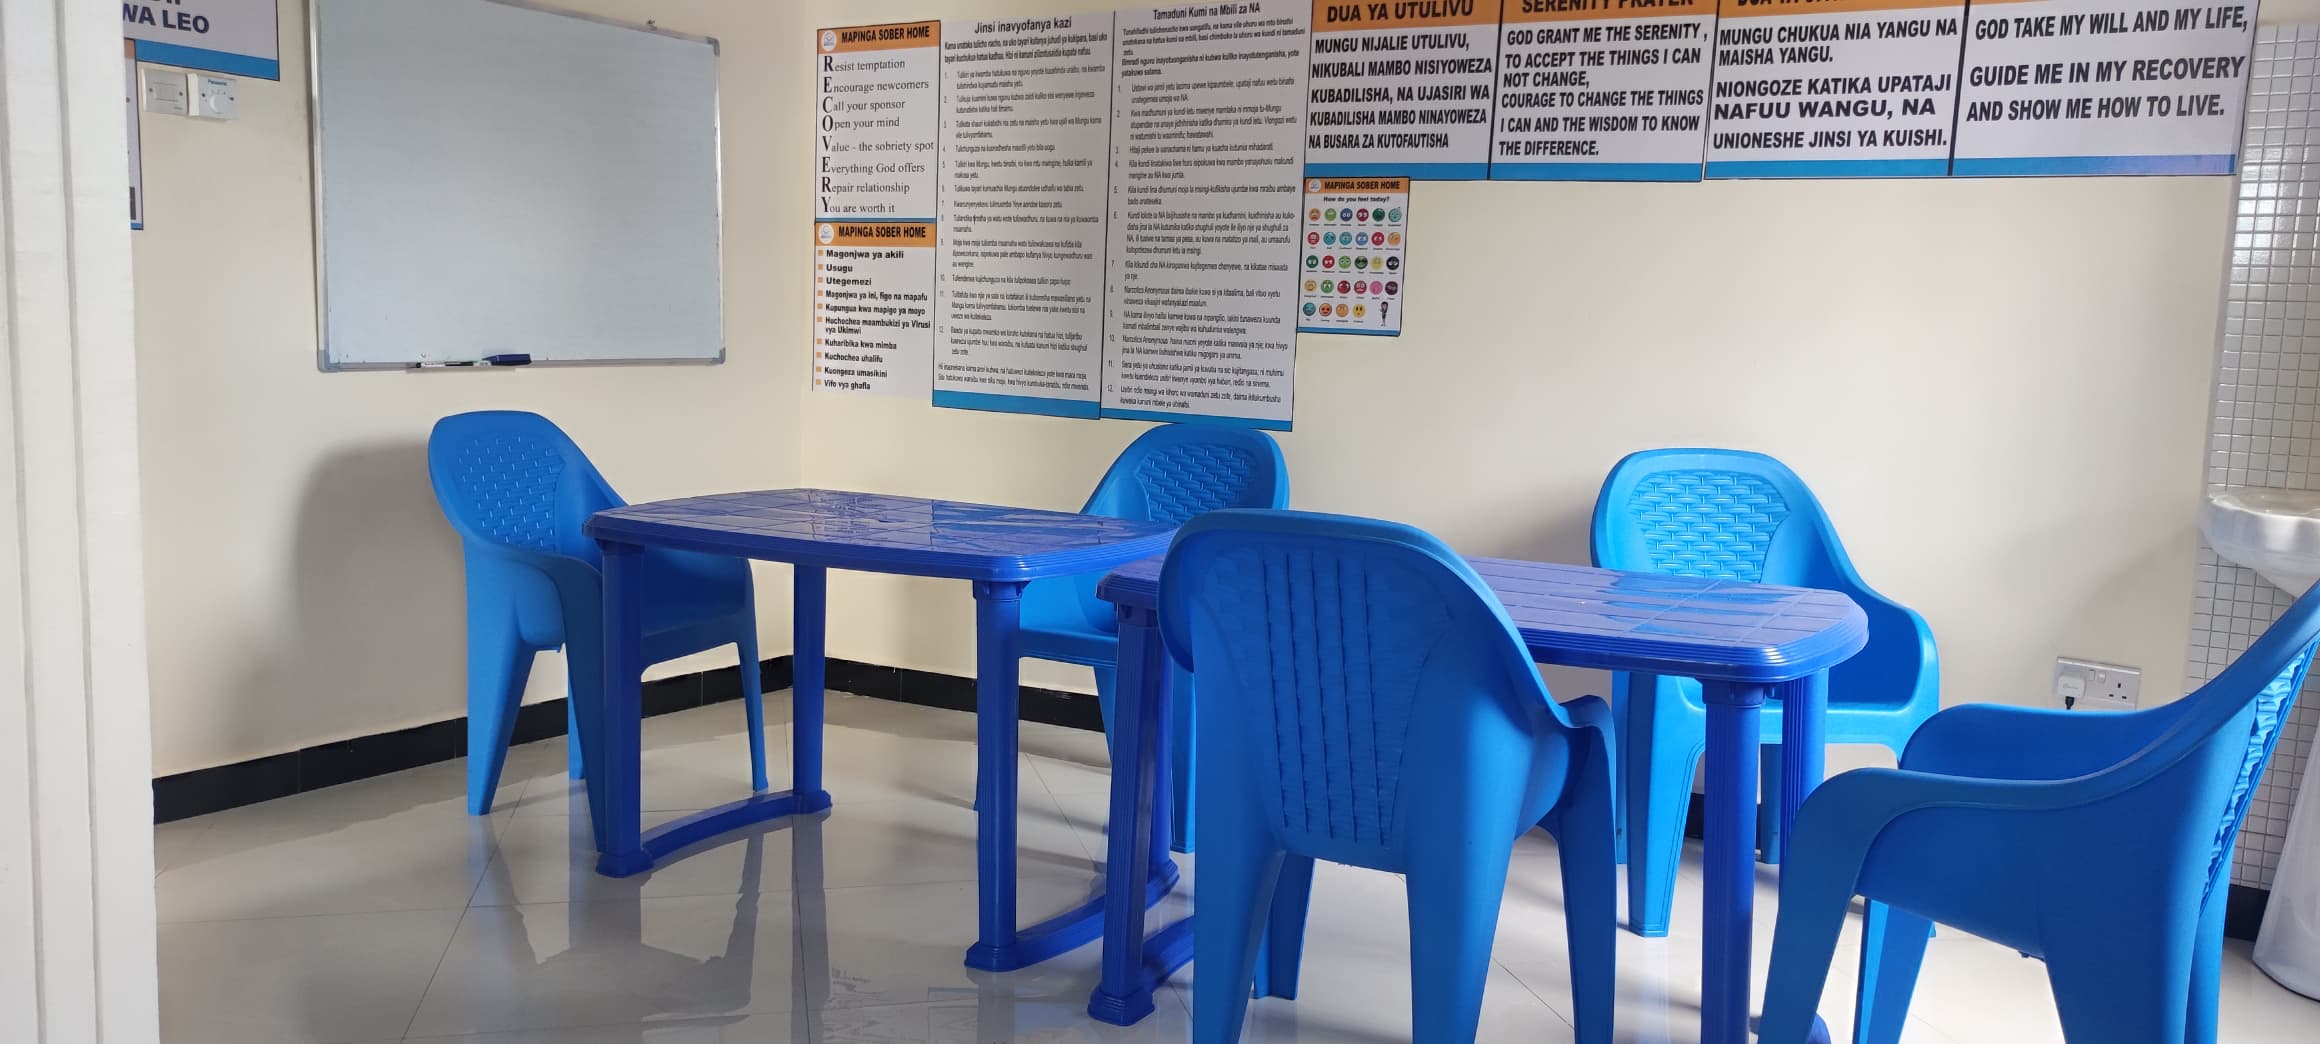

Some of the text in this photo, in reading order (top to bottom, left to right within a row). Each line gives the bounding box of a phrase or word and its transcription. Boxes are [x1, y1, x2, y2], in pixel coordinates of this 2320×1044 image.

[1153, 2, 1260, 20] Tamaduni Kumi na Mbili za NA
[1327, 0, 1473, 23] DUA YA UTULIVU
[162, 9, 209, 33] LEO
[974, 16, 1072, 34] Jinsi inavyofanya kazi
[1975, 6, 2247, 40] GOD TAKE MY WILL AND MY LIFE,
[841, 26, 930, 42] MAPINGA SOBER HOME
[1507, 23, 1700, 45] GOD GRANT ME THE SERENITY
[1719, 18, 1957, 45] MUNGU CHUKUA NIA YANGU NA
[1315, 37, 1358, 53] MUNGU
[1361, 35, 1408, 51] NIJALIE
[1411, 33, 1469, 50] UTULIVU,
[824, 55, 905, 72] Resist temptation
[1506, 48, 1701, 69] TO ACCEPT THE THINGS I CAN
[1719, 45, 1832, 66] MAISHA YANGU.
[1311, 62, 1365, 78] NIKUBALI
[1368, 60, 1411, 76] MAMBO
[1414, 58, 1491, 74] NISIYOWEZA
[1970, 56, 2245, 86] GUIDE ME IN MY RECOVERY
[823, 76, 929, 93] Encourage newcomers
[1503, 70, 1589, 88] NOT CHANGE,
[1716, 74, 1951, 97] NIONGOZE KATIKA UPATAJI
[1311, 87, 1392, 103] KUBADILISHA,
[1396, 86, 1413, 101] NA
[1417, 85, 1466, 101] UJASIRI
[1470, 84, 1489, 100] WA
[1501, 89, 1703, 108] COURAGE TO CHANGE THE THINGS
[822, 96, 905, 113] Call your sponsor
[1714, 98, 1935, 120] NAFUU WANGU, NA
[1966, 94, 2224, 121] AND SHOW ME HOW TO LIVE.
[822, 115, 900, 132] Open your mind
[1310, 111, 1375, 126] KUBADILISHA
[1378, 110, 1416, 124] MAMBO
[1418, 108, 1486, 124] NINAYOWEZA
[1500, 115, 1700, 132] I CAN AND THE WISDOM TO KNOW
[823, 135, 850, 152] Value
[858, 141, 873, 151] the
[875, 141, 912, 152] sobriety
[914, 141, 934, 152] spot
[1308, 133, 1448, 149] NA BUSARA ZA KUTOFAUTISHA
[1499, 140, 1598, 155] THE DIFFERENCE.
[1713, 129, 1946, 149] UNIONESHE JINSI YA KUISHI.
[822, 156, 925, 175] Everything God offers
[821, 176, 910, 194] Repair relationship
[1324, 180, 1400, 189] MAPINGA SOBER HOME
[820, 196, 895, 213] You are worth it
[838, 226, 926, 238] MAPINGA SOBER HOME
[826, 249, 904, 260] Magonjwa ya akili
[826, 263, 853, 274] Usugu
[826, 277, 871, 286] Utegemezi
[825, 290, 857, 300] Magonjwa
[859, 292, 867, 300] ya
[879, 292, 892, 302] figo
[903, 293, 928, 302] mapafu
[824, 352, 883, 363] Kuchochea uhalifu
[824, 366, 887, 377] Kuongeza umasikini
[824, 379, 870, 390] Vifo vya ghafla
